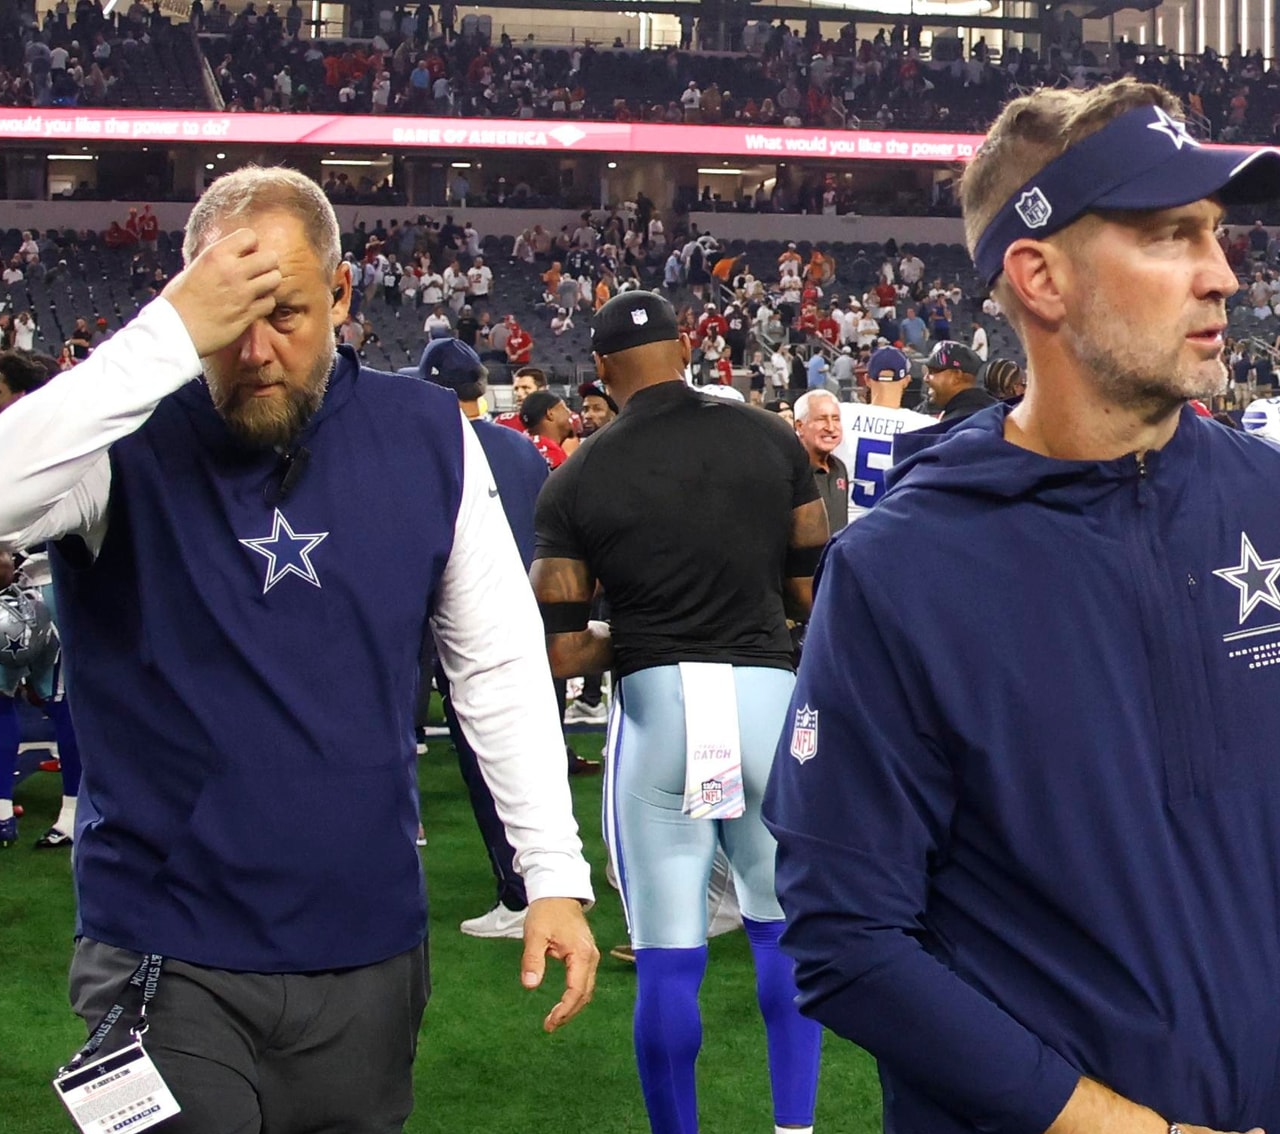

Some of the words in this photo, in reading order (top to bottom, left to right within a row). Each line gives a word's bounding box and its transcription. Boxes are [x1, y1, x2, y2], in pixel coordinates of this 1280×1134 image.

[45, 120, 72, 135] you
[75, 116, 101, 133] like
[105, 117, 129, 133] the
[133, 121, 179, 138] power
[182, 119, 199, 135] to
[203, 119, 231, 136] do?
[393, 128, 441, 143] BANK
[443, 129, 467, 144] OF
[469, 130, 548, 145] AMERICA
[745, 135, 783, 150] What
[786, 137, 827, 151] would
[830, 140, 855, 155] you
[858, 139, 882, 153] like
[886, 139, 909, 154] the
[912, 142, 954, 156] power
[958, 143, 972, 156] to
[851, 415, 905, 436] ANGER
[851, 437, 893, 509] 5
[794, 730, 814, 754] NFL
[693, 749, 731, 760] CATCH
[704, 790, 720, 802] NFL
